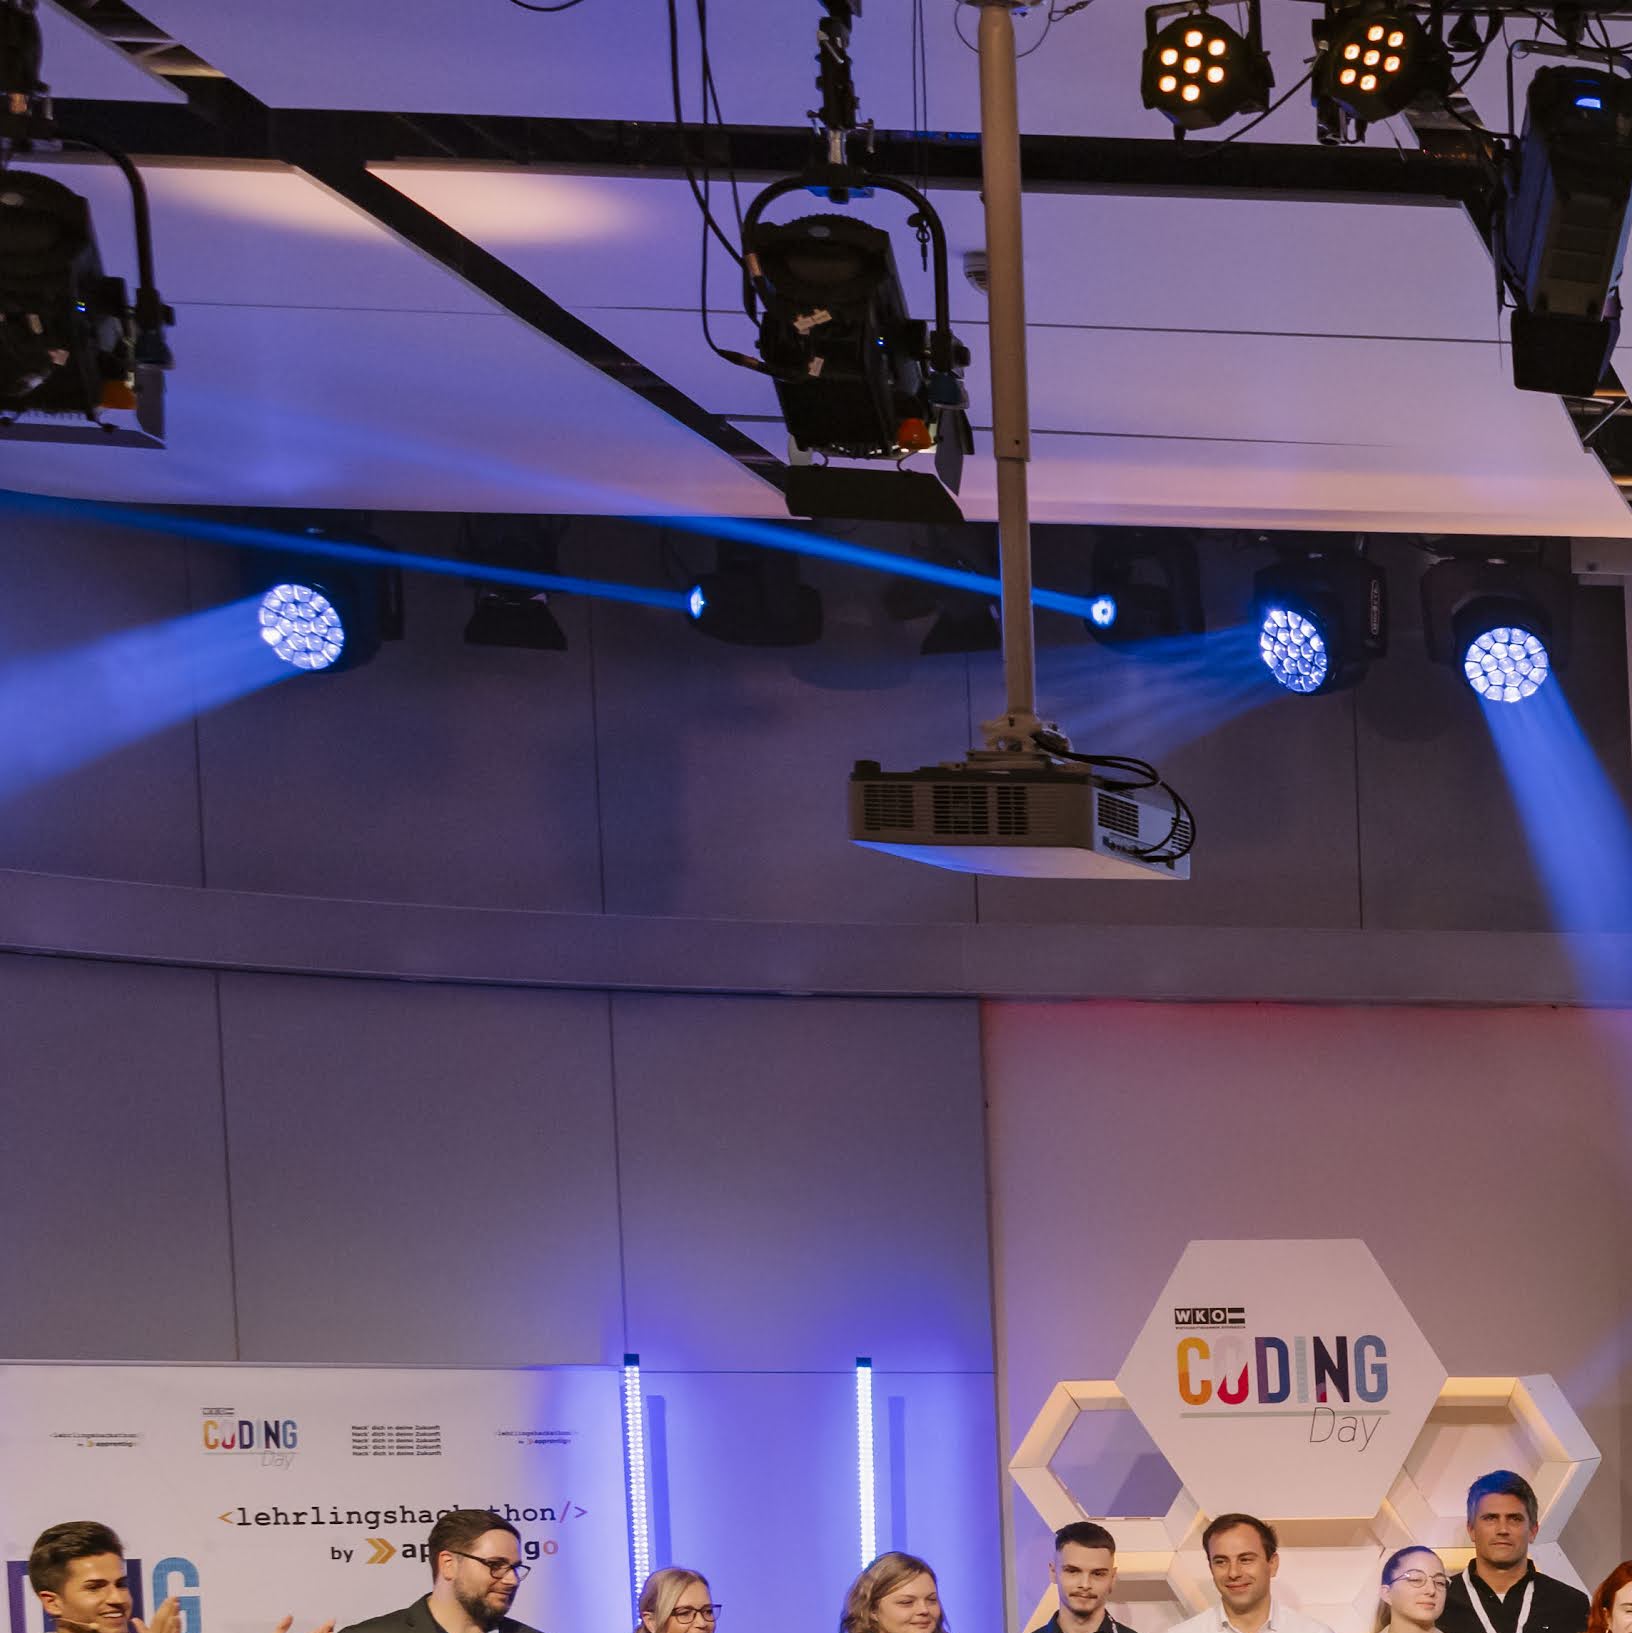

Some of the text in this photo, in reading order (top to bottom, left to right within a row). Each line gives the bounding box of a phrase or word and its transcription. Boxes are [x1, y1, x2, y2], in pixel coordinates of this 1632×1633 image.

[1175, 1309, 1226, 1323] WKO
[1176, 1334, 1388, 1405] CODING
[202, 1418, 299, 1450] CODING
[1309, 1406, 1382, 1452] Day
[331, 1547, 353, 1562] by
